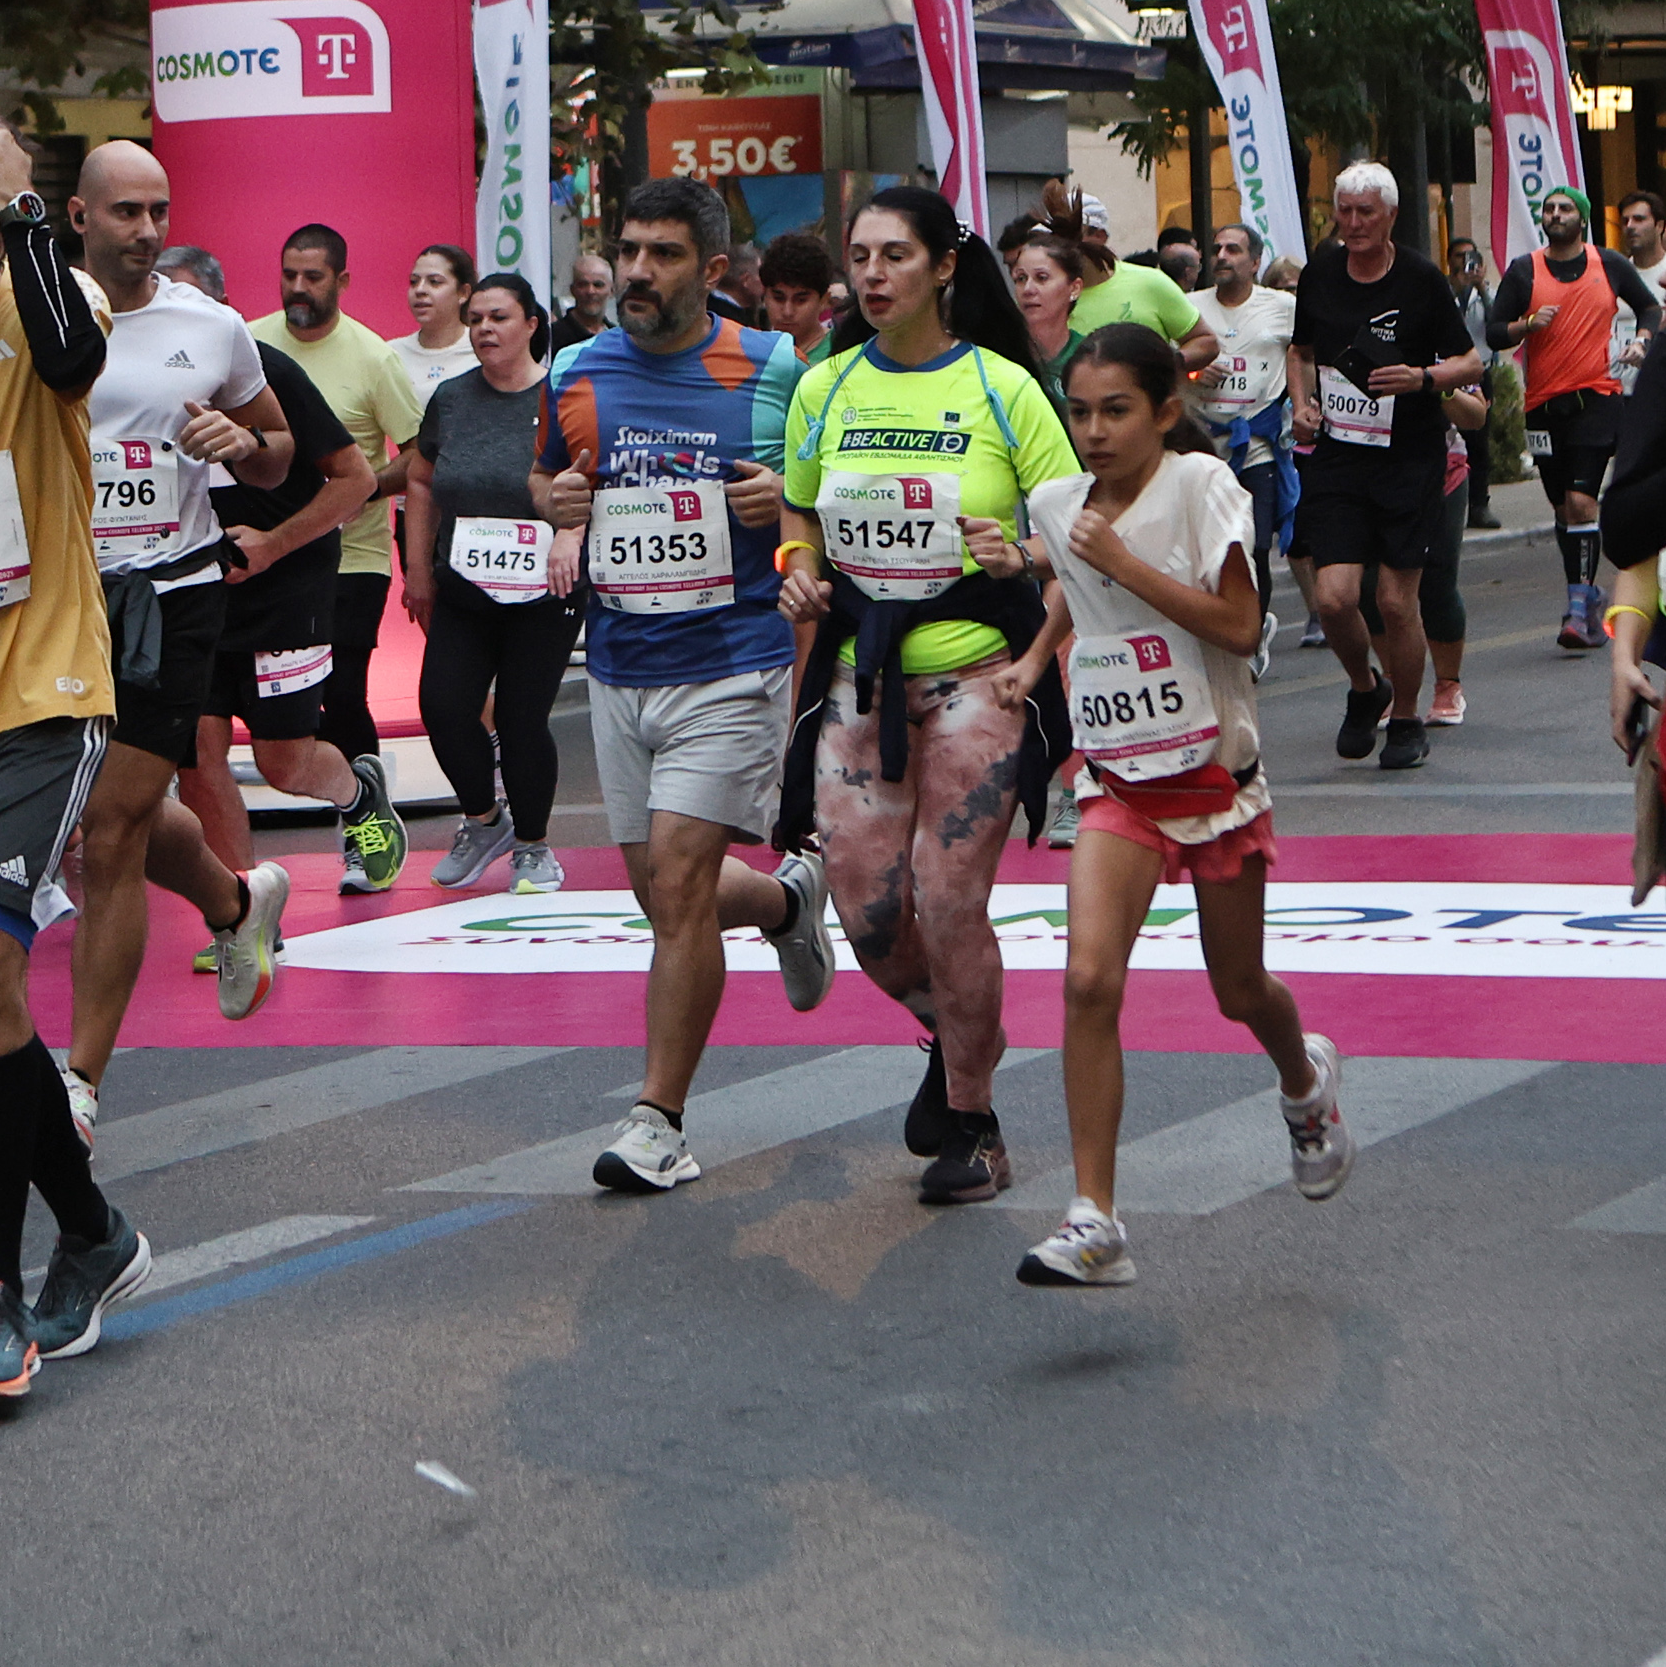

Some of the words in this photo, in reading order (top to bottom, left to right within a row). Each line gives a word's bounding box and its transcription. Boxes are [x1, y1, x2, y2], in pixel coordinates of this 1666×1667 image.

[157, 47, 280, 83] COSMOTE
[164, 361, 196, 370] adidas
[1214, 376, 1247, 391] 718
[1327, 393, 1380, 416] 50079
[614, 426, 718, 446] Stoiximan
[842, 431, 933, 448] #BEACTIVE
[97, 478, 156, 509] 796
[834, 486, 896, 500] COSMOTE
[606, 503, 667, 516] COSMOTE
[469, 528, 514, 538] COSMOTE
[838, 519, 935, 549] 51547
[610, 532, 707, 565] 51353
[466, 548, 536, 571] 51475
[1082, 680, 1183, 728] 50815
